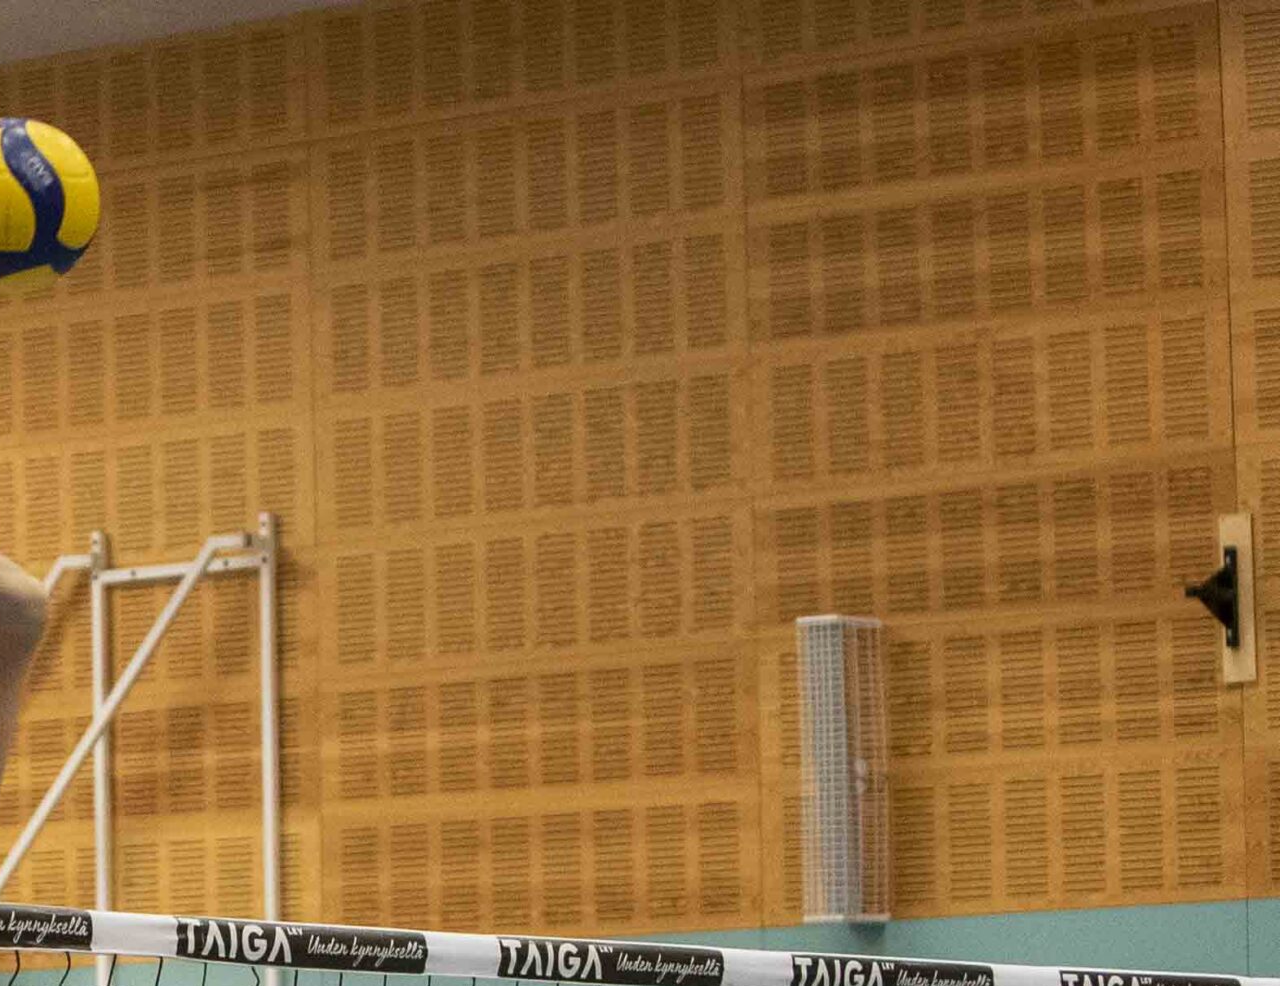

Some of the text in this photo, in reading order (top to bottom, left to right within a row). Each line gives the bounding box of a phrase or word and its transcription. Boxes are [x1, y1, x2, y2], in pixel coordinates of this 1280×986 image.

[7, 910, 89, 943] kynnyksellä
[177, 917, 293, 964] TAIGA
[307, 934, 349, 957] Uuden
[351, 936, 424, 968] kynnyksellä
[500, 938, 603, 980] TAIGA
[616, 951, 654, 973] Uuden
[654, 953, 721, 985] kynnyksellä
